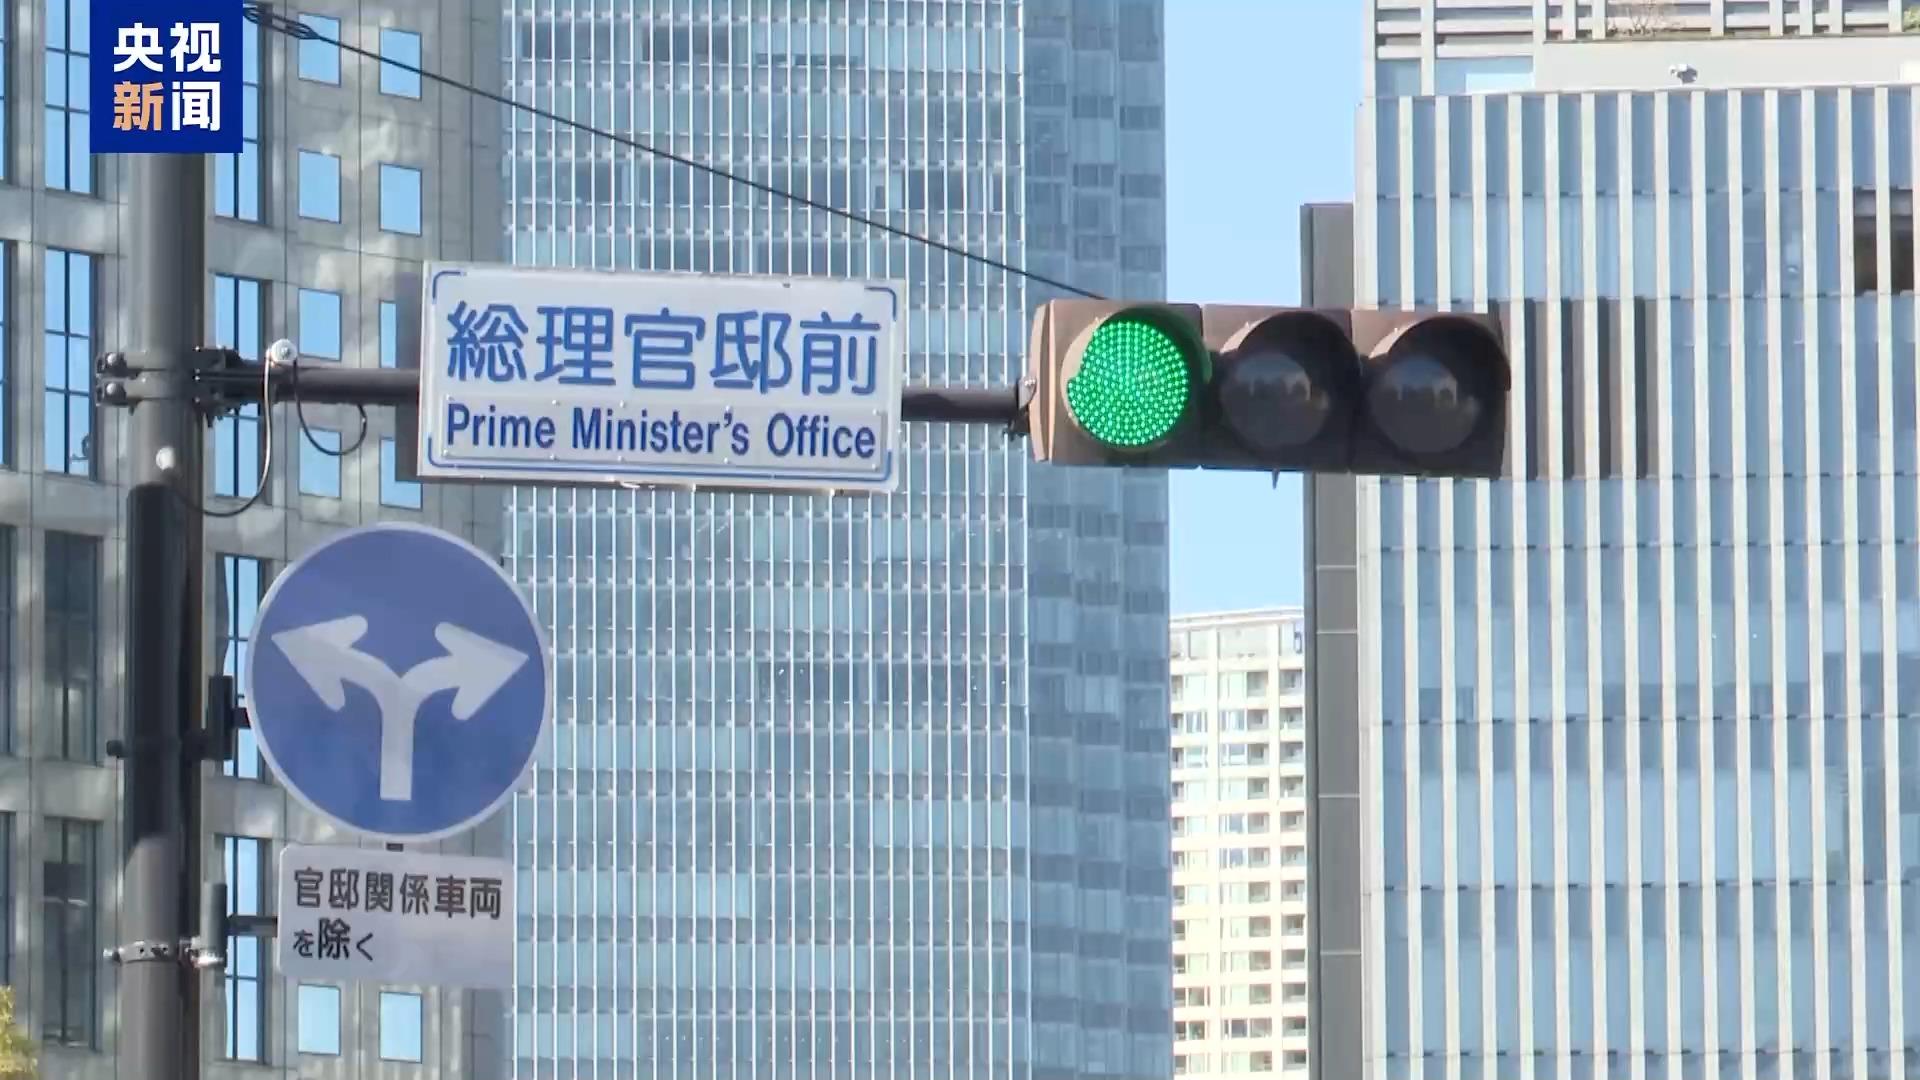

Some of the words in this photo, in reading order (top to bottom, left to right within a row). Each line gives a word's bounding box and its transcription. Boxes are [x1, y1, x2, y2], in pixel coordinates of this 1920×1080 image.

[447, 300, 881, 395] 総理官邸前
[447, 403, 556, 449] Prime
[572, 406, 750, 456] Minister’s
[767, 411, 876, 459] Office
[294, 866, 502, 919] 官邸関係車両
[293, 917, 374, 961] を除く
